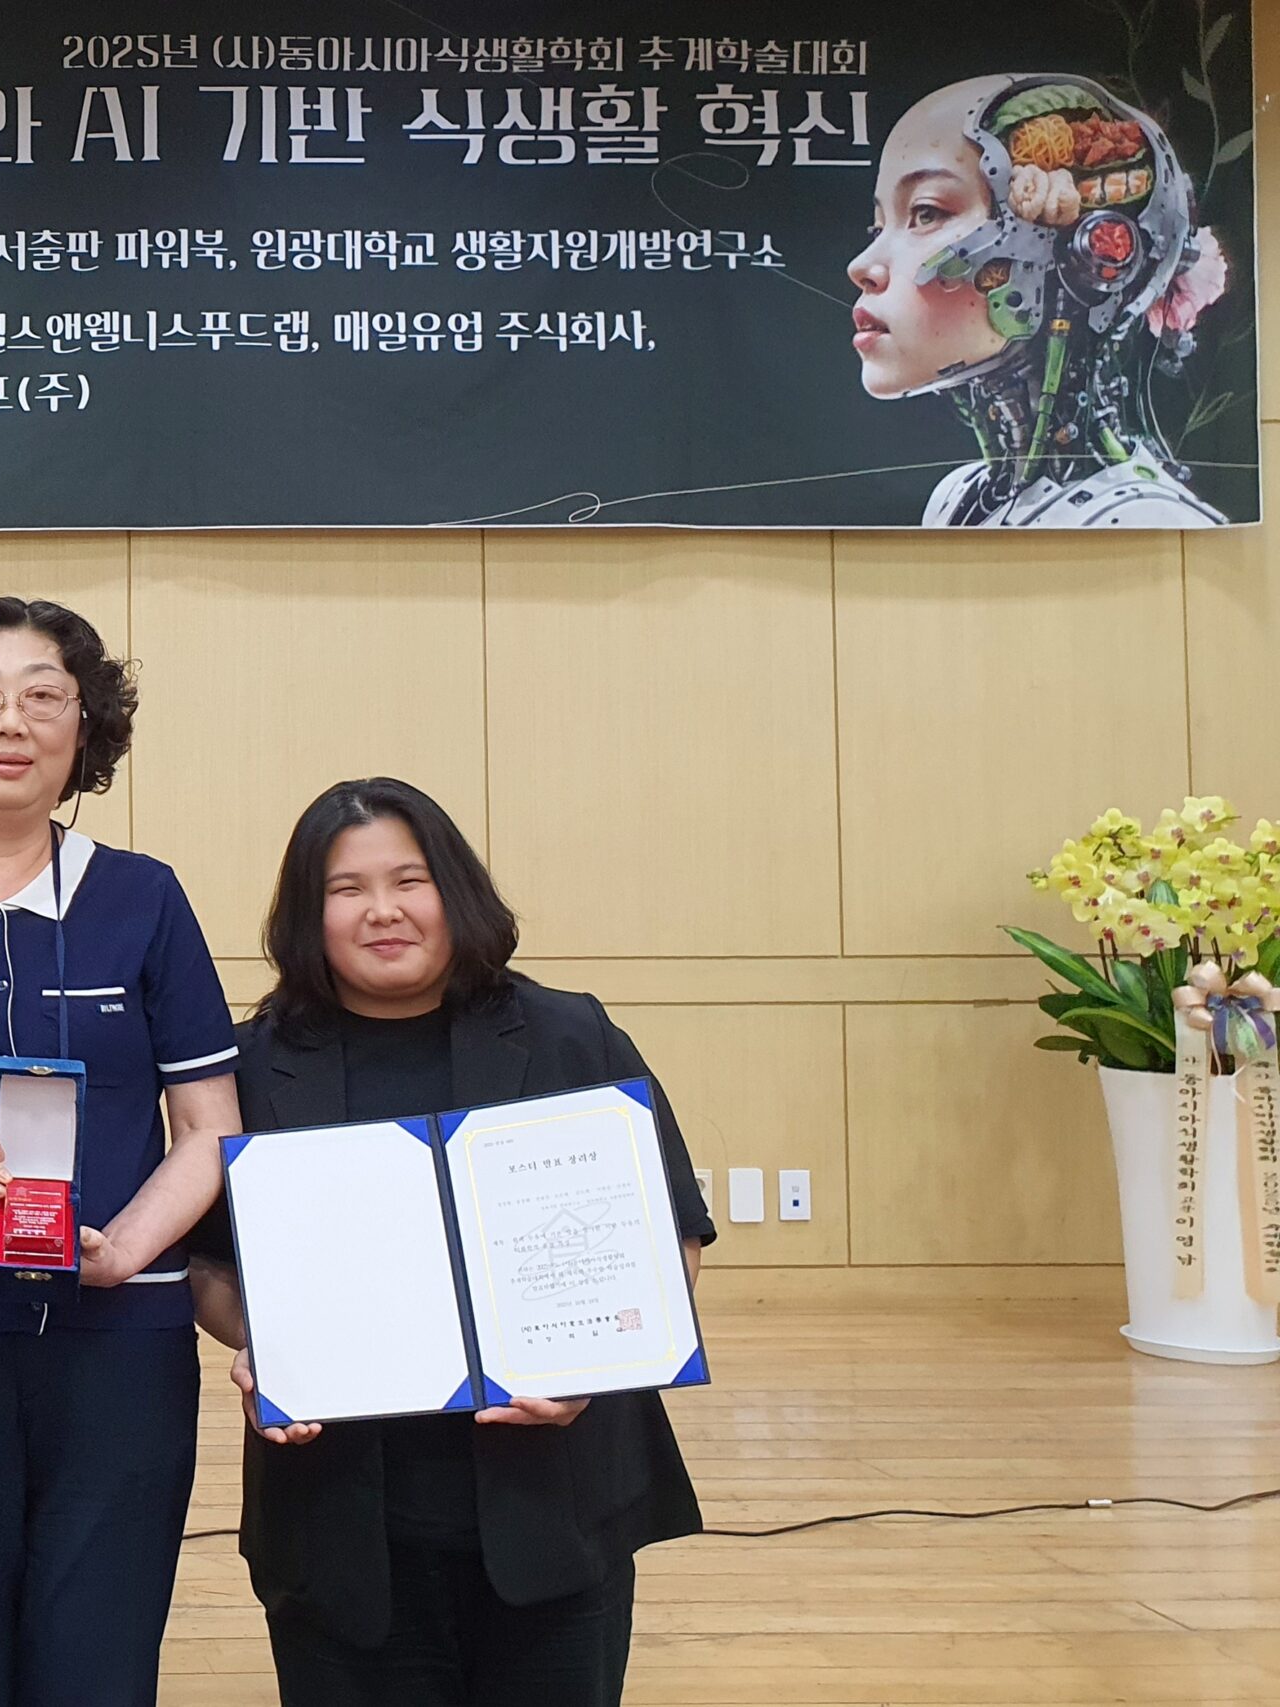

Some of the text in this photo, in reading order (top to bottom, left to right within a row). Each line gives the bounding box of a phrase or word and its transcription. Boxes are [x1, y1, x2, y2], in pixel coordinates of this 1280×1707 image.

[63, 34, 867, 76] 2025년 (사)동아시아식생활학회 추계학술대회
[70, 85, 161, 162] AI
[198, 85, 373, 164] 기반
[401, 84, 668, 165] 식생활
[696, 83, 872, 166] 혁신
[115, 228, 237, 271] 파워북,
[250, 229, 439, 271] 원광대학교
[451, 229, 786, 271] 생활자원개발연구소
[334, 310, 483, 352] 매일유업
[495, 310, 656, 353] 주식회사,
